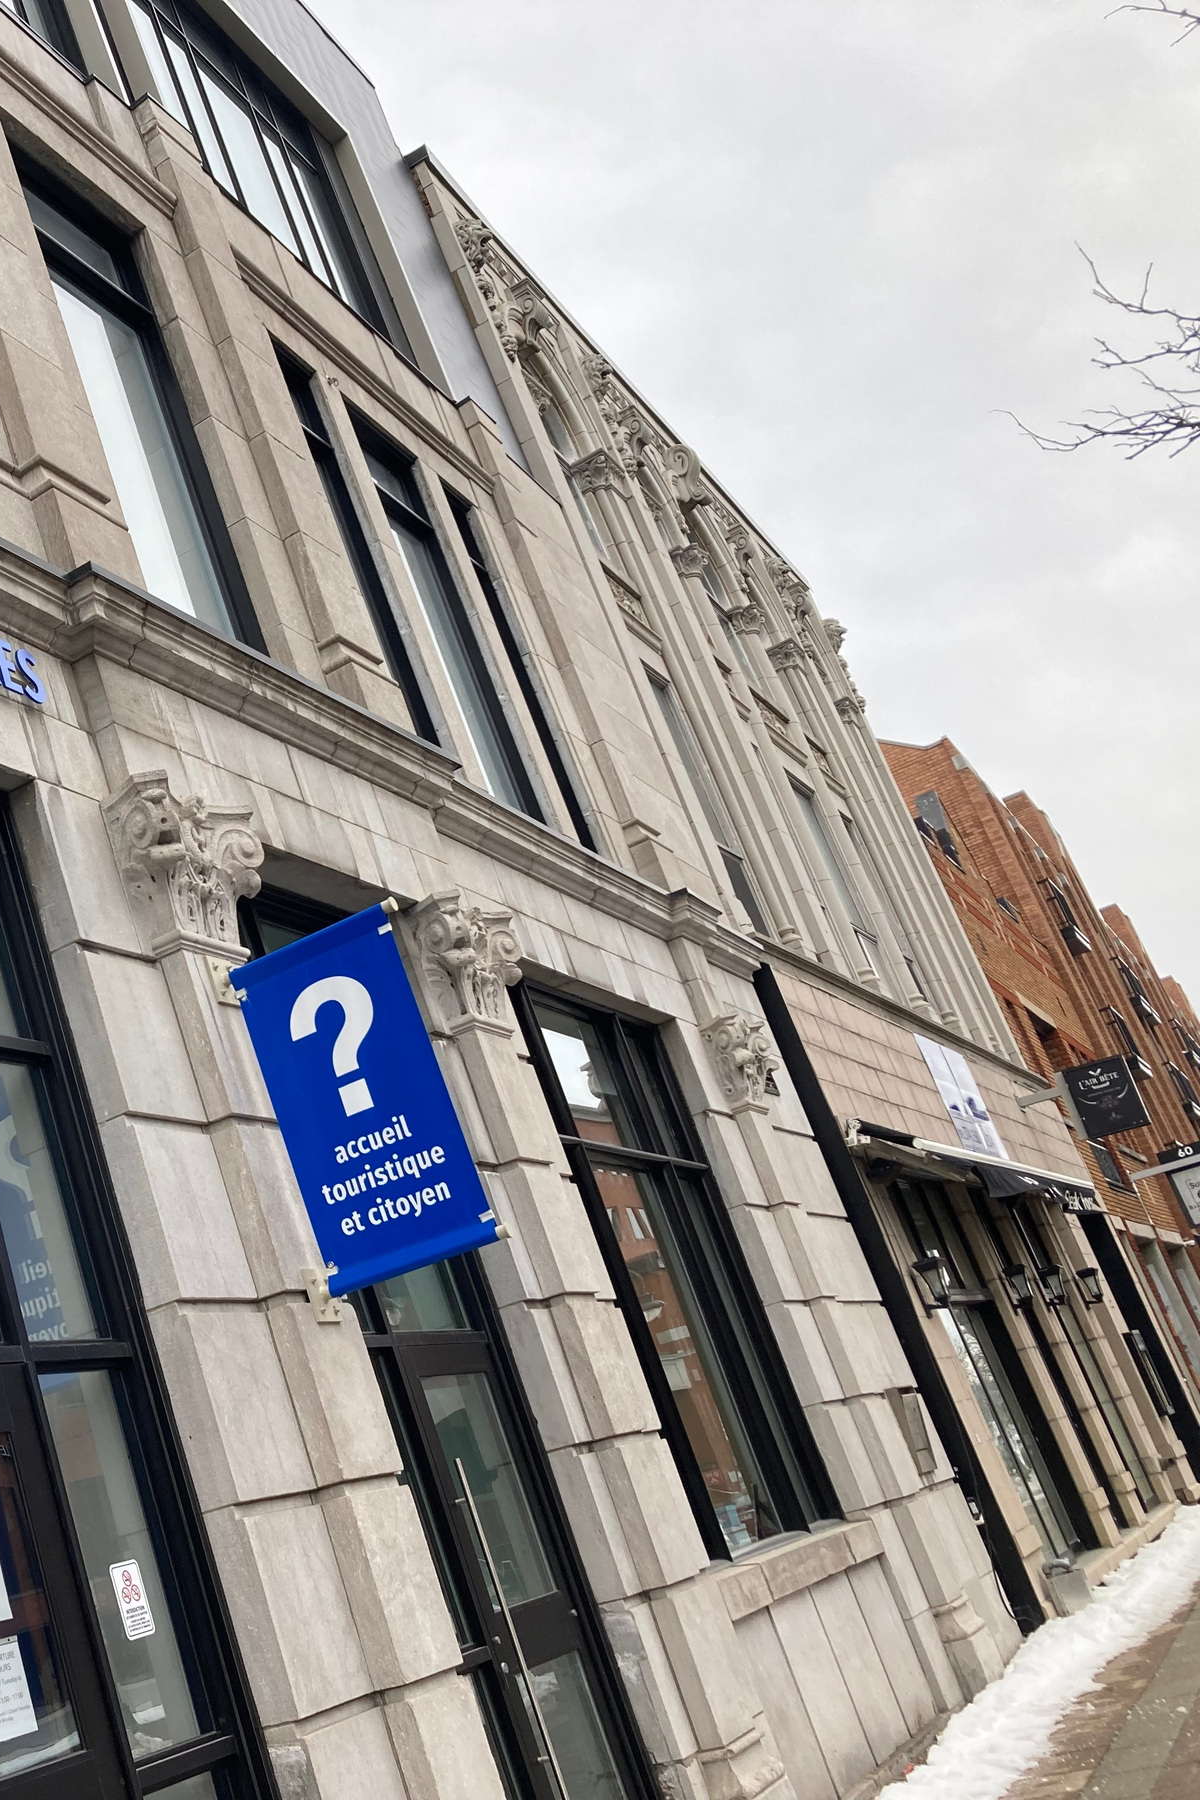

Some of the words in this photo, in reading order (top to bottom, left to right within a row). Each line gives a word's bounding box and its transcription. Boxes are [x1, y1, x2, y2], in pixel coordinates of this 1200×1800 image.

[333, 1114, 412, 1164] accueil
[1177, 1145, 1194, 1158] 60
[321, 1145, 445, 1205] touristique
[340, 1210, 366, 1236] et
[368, 1182, 452, 1225] citoyen
